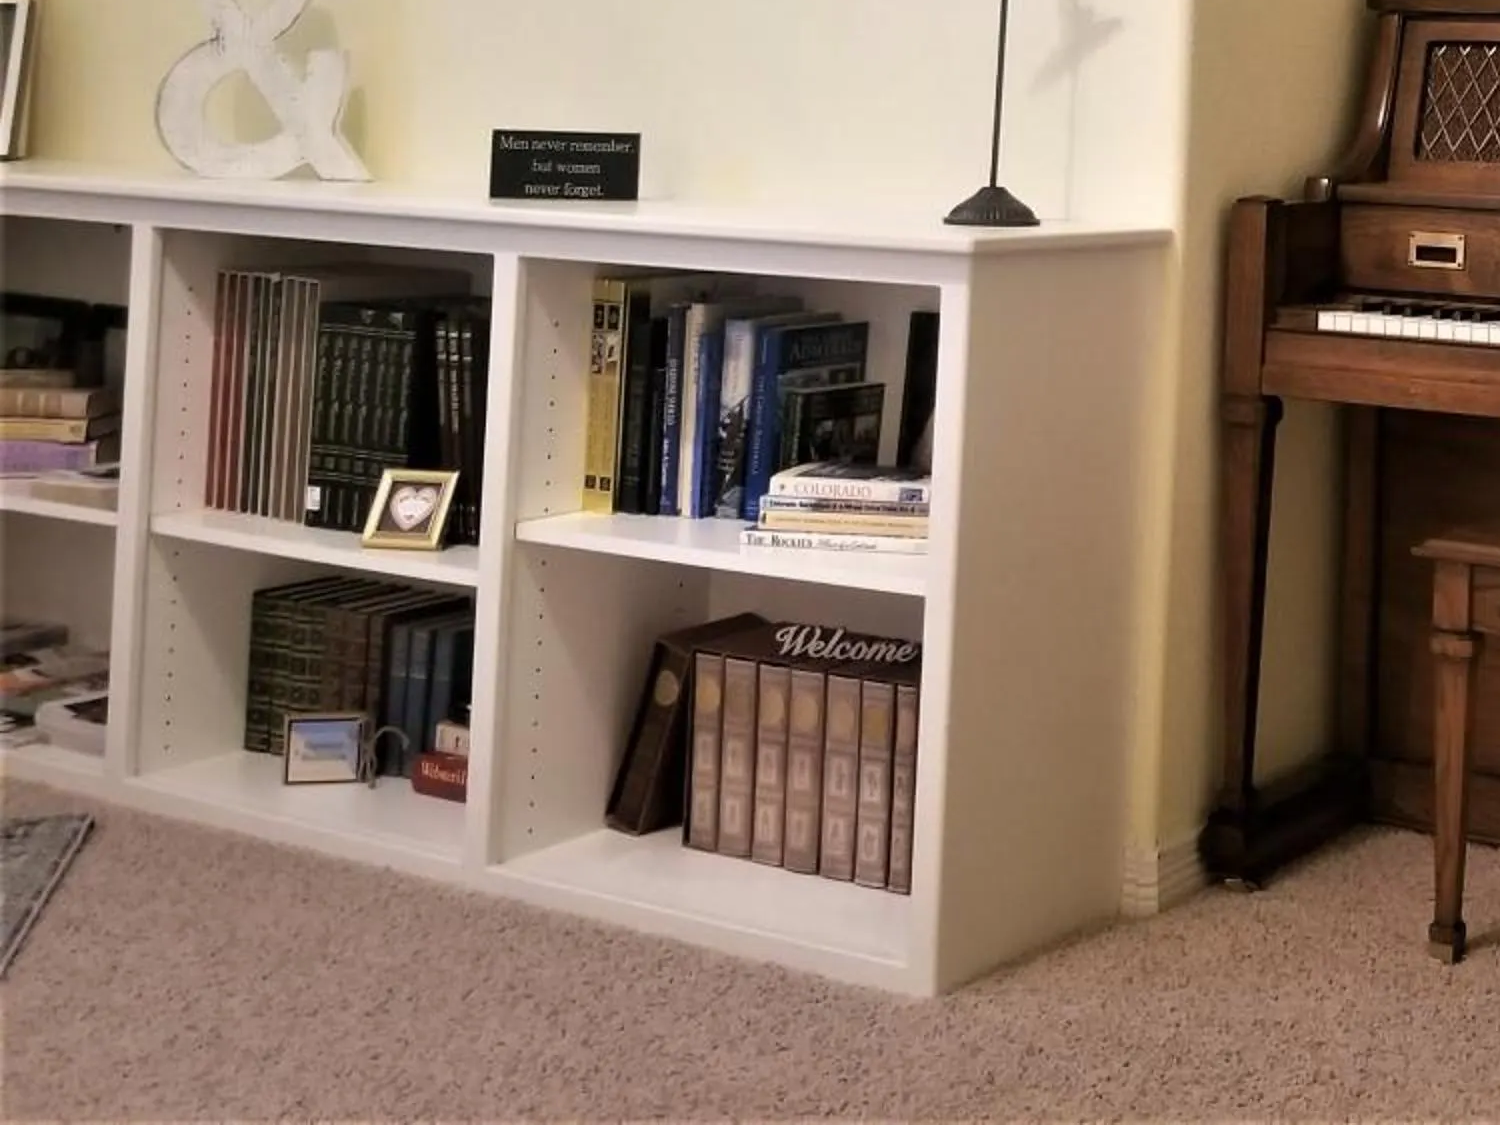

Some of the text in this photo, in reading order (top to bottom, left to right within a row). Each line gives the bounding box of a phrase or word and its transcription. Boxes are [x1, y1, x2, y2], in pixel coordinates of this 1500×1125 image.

[500, 135, 529, 151] Men
[531, 139, 566, 152] never
[531, 159, 601, 174] but women
[524, 183, 561, 196] never
[775, 624, 920, 663] Welcome
